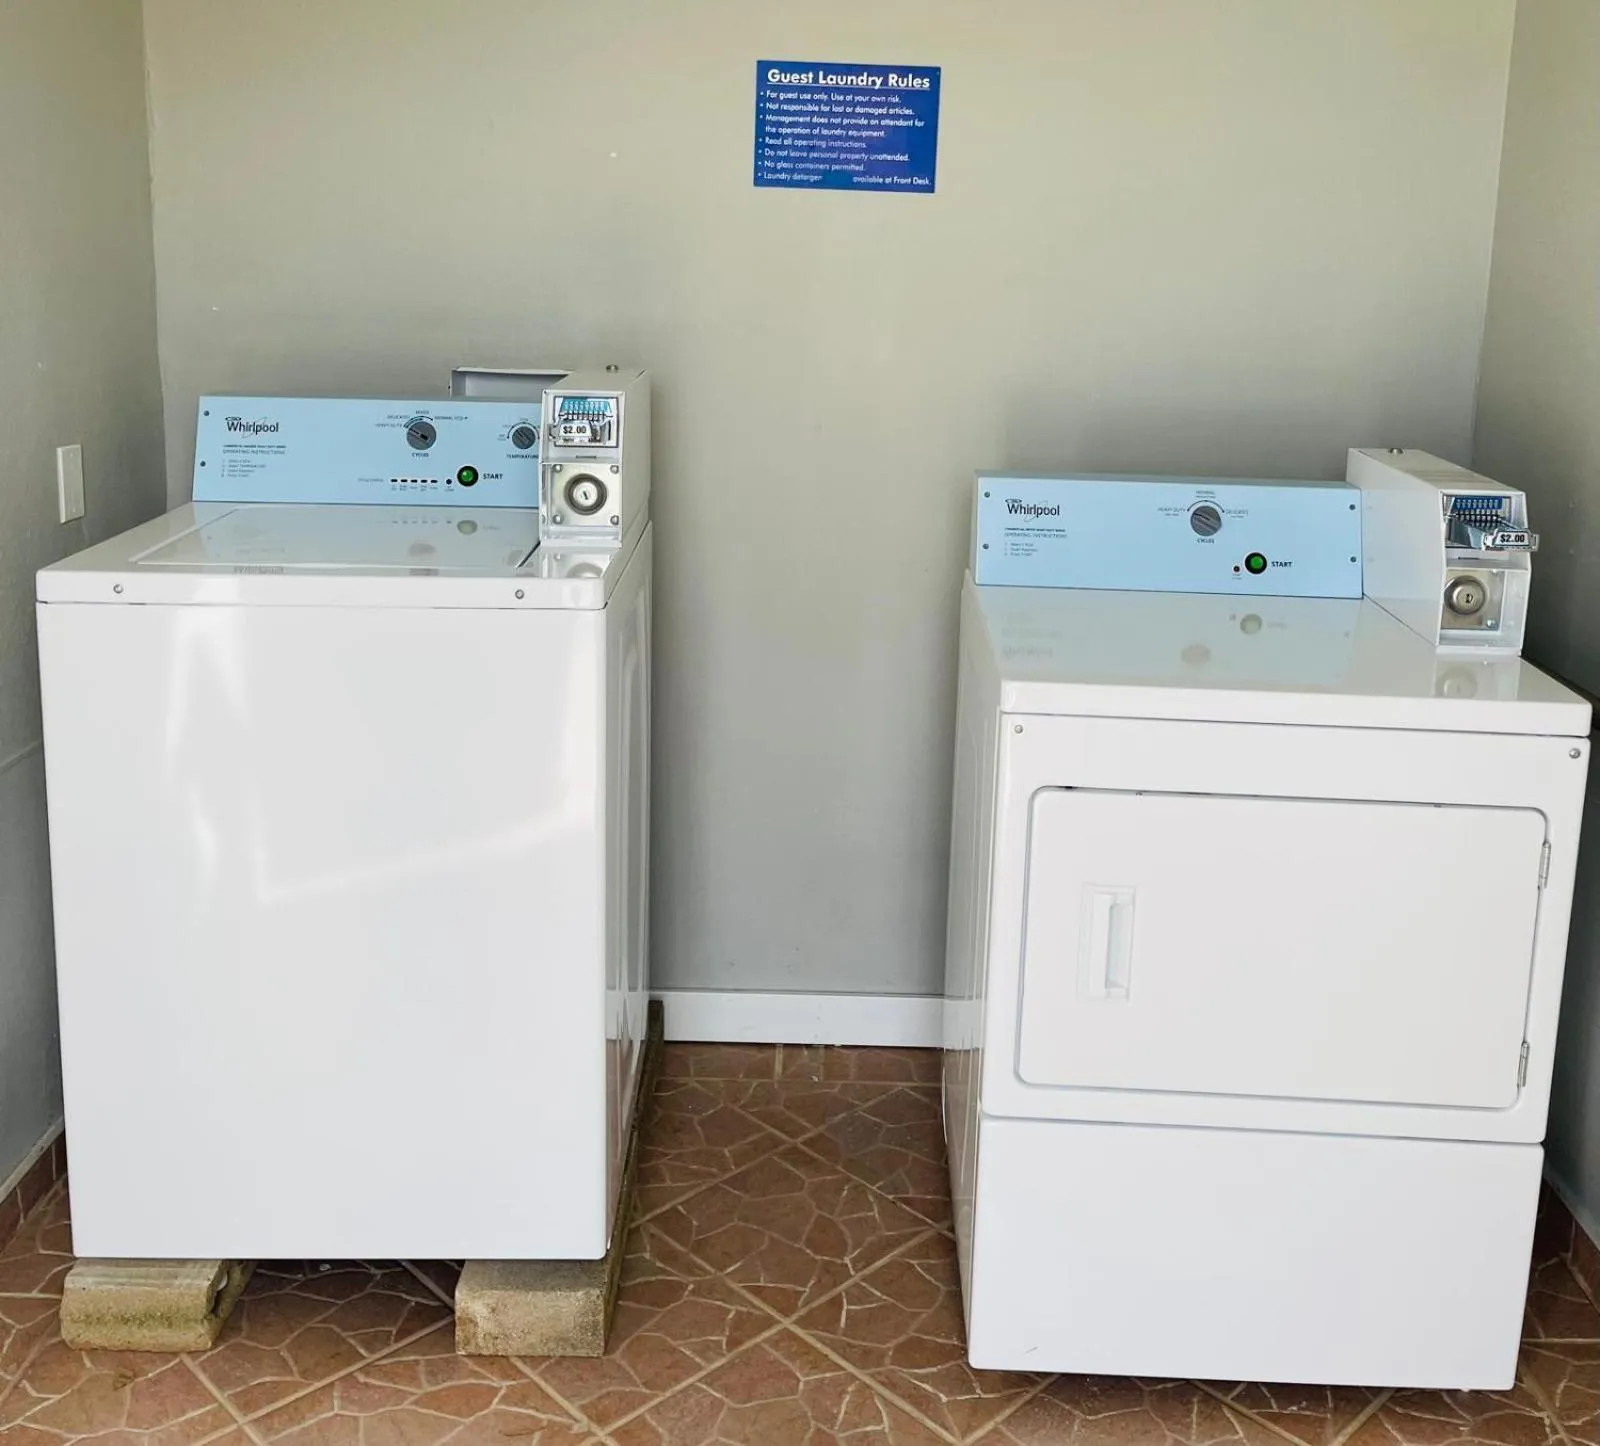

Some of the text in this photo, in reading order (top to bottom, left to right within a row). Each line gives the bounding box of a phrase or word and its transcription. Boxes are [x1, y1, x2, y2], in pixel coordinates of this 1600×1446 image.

[767, 69, 930, 89] Guest Laundry Rules
[766, 90, 778, 98] For
[779, 92, 798, 100] guest
[830, 92, 844, 100] Use
[887, 95, 901, 103] risk.
[766, 102, 779, 110] Not
[780, 103, 819, 111] responsible
[855, 105, 887, 115] damaged
[888, 107, 915, 115] articles.
[765, 114, 811, 123] Management
[812, 115, 828, 123] does
[843, 117, 868, 125] provide
[880, 118, 913, 126] attendant
[914, 118, 925, 126] for
[777, 127, 811, 135] operation
[821, 128, 846, 137] laundry
[765, 136, 782, 144] Read
[783, 137, 792, 145] all
[793, 138, 826, 148] operating
[764, 148, 775, 156] Do
[840, 152, 868, 161] property
[869, 153, 910, 161] unattended.
[776, 161, 793, 169] glass
[764, 172, 791, 181] Laundry
[853, 175, 883, 183] available
[893, 176, 911, 184] Front
[912, 177, 931, 185] Desk.
[227, 421, 279, 436] Whirlpool
[563, 425, 587, 434] $2.00
[1007, 503, 1060, 518] Whirlpool
[1500, 533, 1525, 543] $2.00
